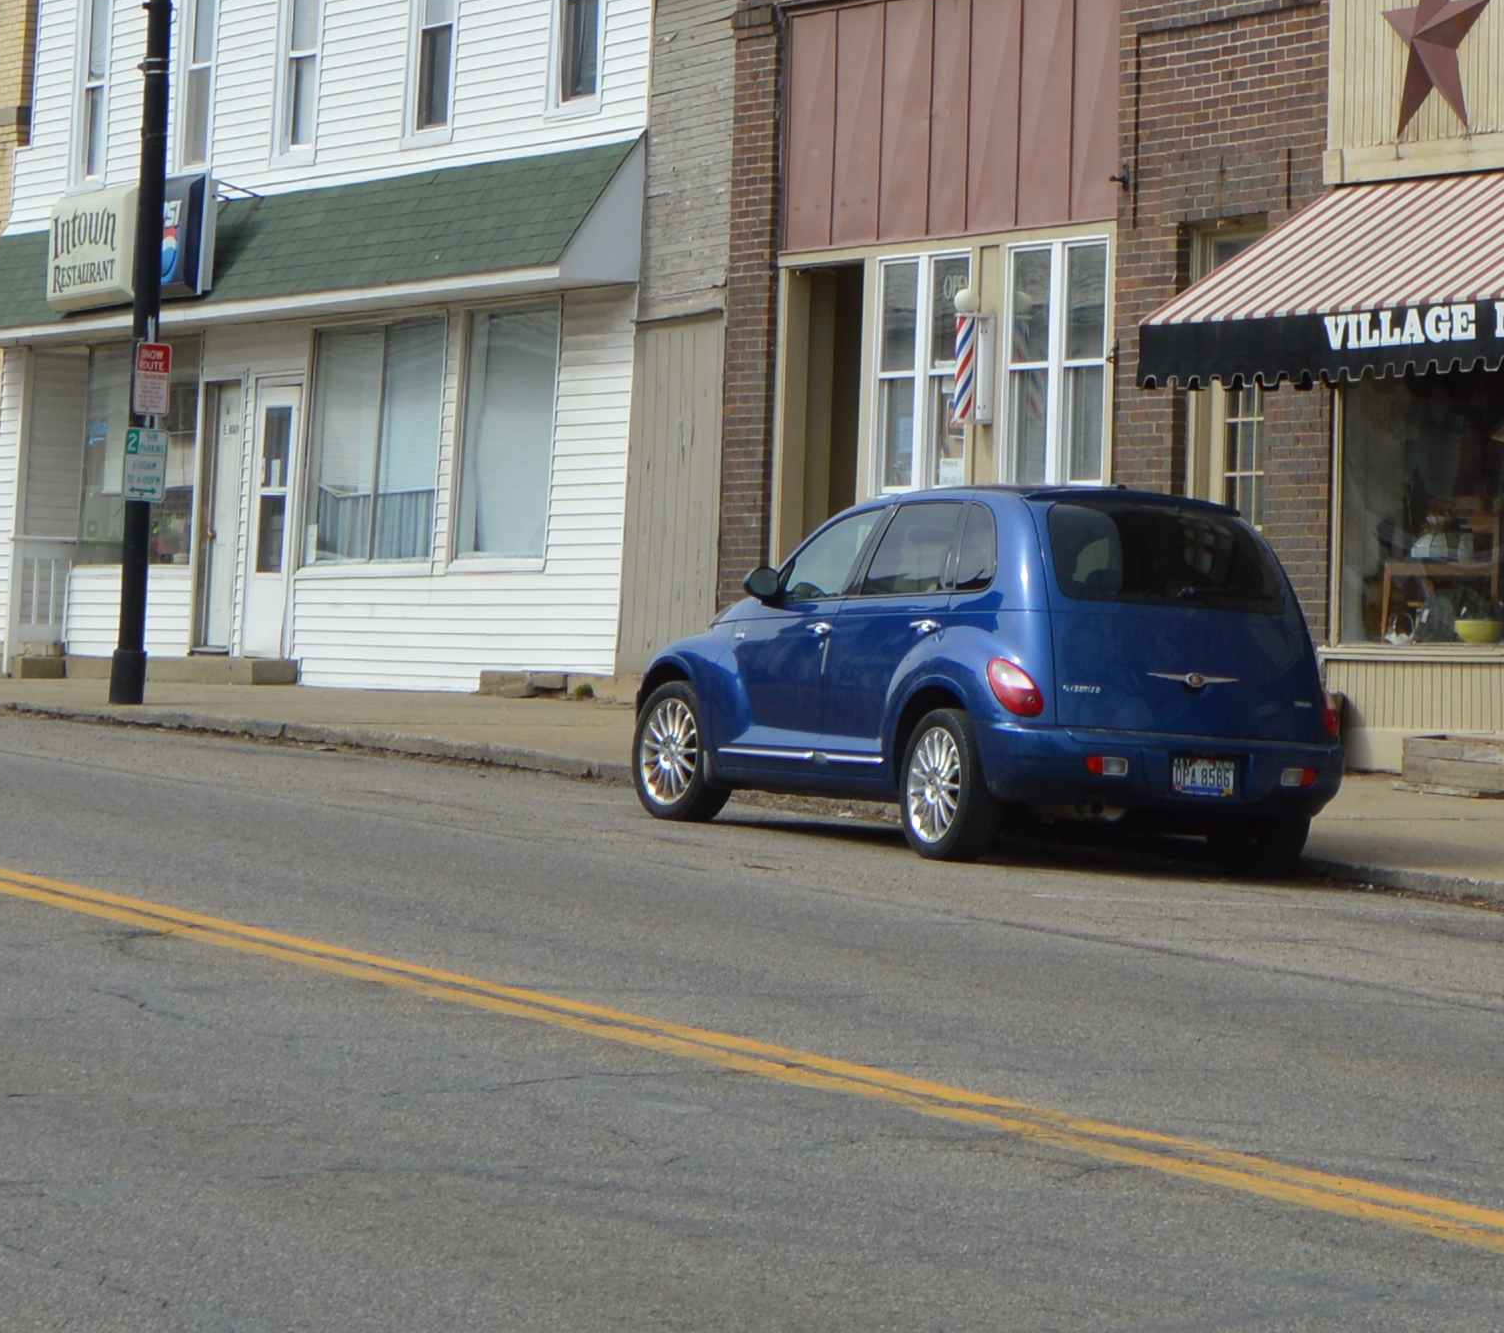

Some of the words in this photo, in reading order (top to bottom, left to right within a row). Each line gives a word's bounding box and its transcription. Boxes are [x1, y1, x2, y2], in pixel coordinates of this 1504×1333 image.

[52, 206, 117, 261] Intown
[52, 258, 116, 293] RESTAURANT
[1323, 302, 1476, 351] VILLAGE
[127, 433, 137, 451] 2
[1201, 768, 1230, 787] 8586
